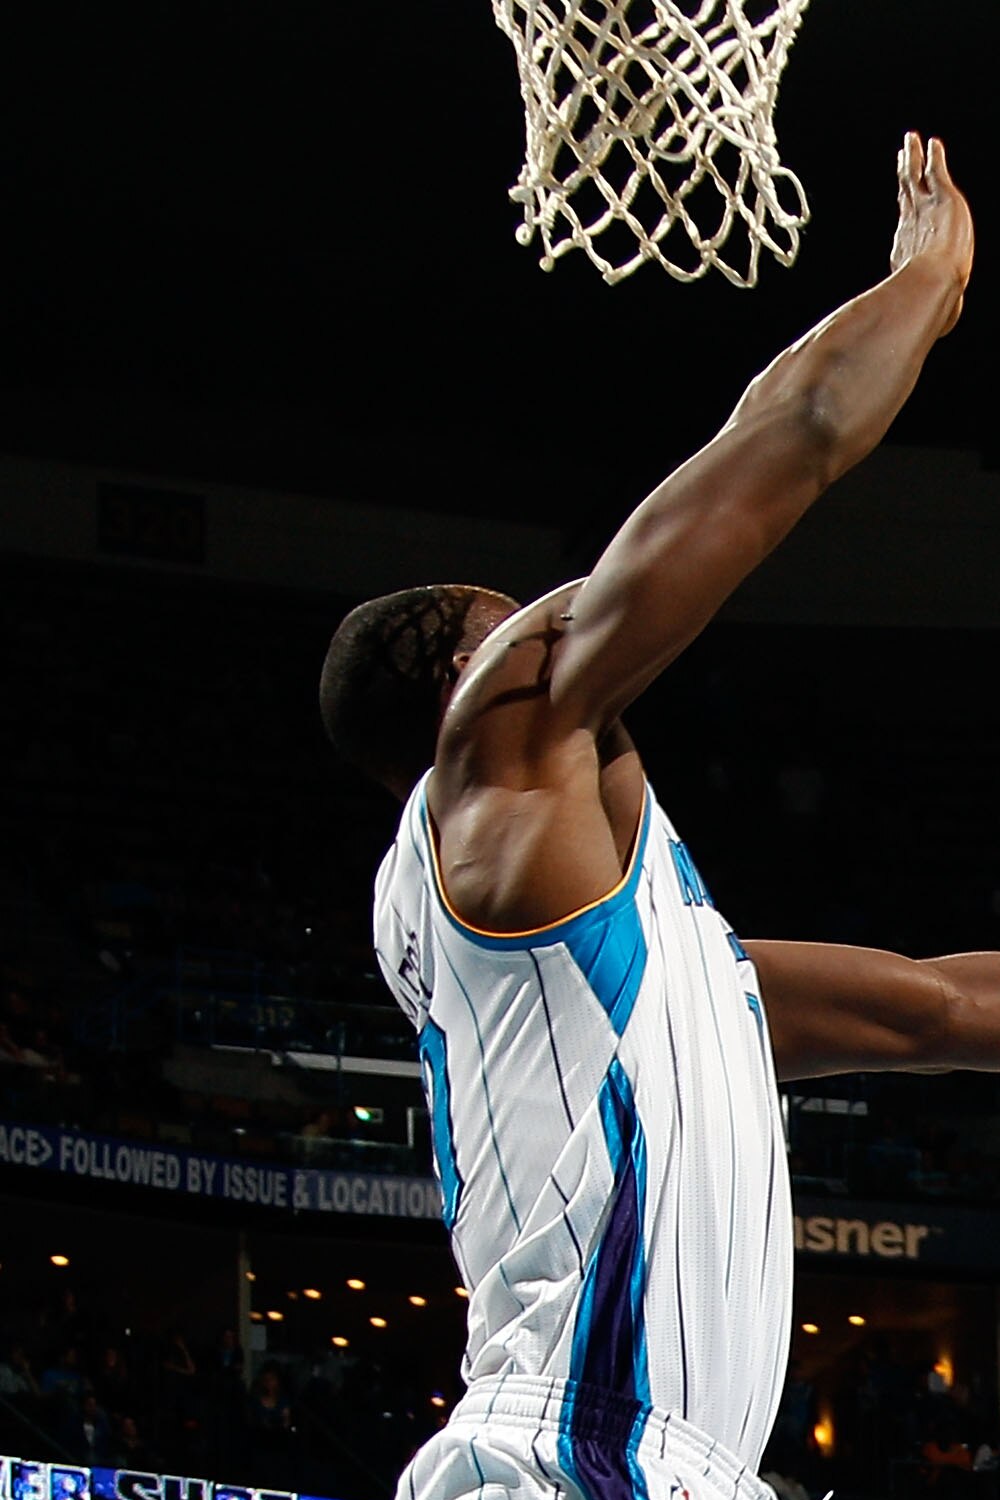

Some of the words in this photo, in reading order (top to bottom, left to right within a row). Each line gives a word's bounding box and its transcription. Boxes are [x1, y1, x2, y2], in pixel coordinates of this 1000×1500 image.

[59, 1135, 181, 1190] FOLLOWED
[186, 1157, 216, 1196] BY
[222, 1163, 288, 1208] ISSUE
[293, 1172, 310, 1210] &
